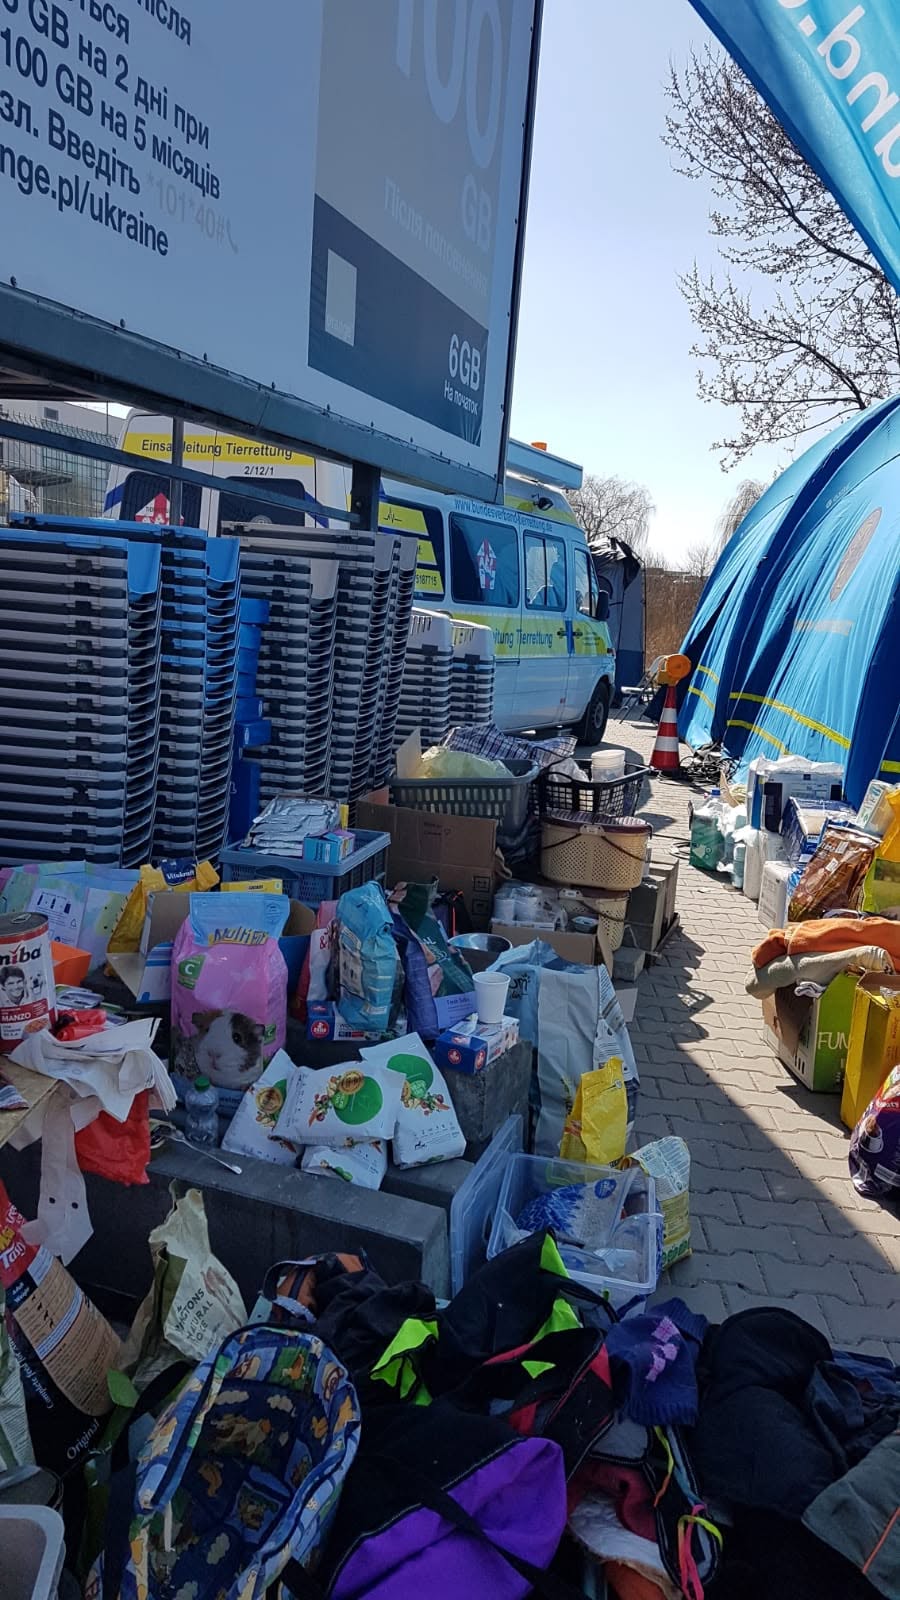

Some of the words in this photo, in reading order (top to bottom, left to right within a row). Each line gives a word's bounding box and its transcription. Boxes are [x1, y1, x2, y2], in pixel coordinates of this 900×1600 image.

[29, 0, 69, 49] GB
[79, 34, 107, 78] на
[115, 54, 129, 93] 2
[134, 77, 168, 120] дні
[174, 104, 209, 149] при
[1, 27, 48, 88] 100
[56, 64, 94, 117] GB
[101, 101, 127, 141] на
[134, 115, 146, 151] 5
[152, 134, 220, 200] місяців
[49, 108, 140, 195] Введіть
[449, 334, 480, 391] 6GB
[444, 380, 453, 402] На
[142, 439, 221, 457] Einsaleitung
[226, 442, 292, 460] Tierrettung
[244, 466, 274, 476] 2/12/1
[1, 1012, 31, 1022] MANZO
[66, 1418, 99, 1460] Original
